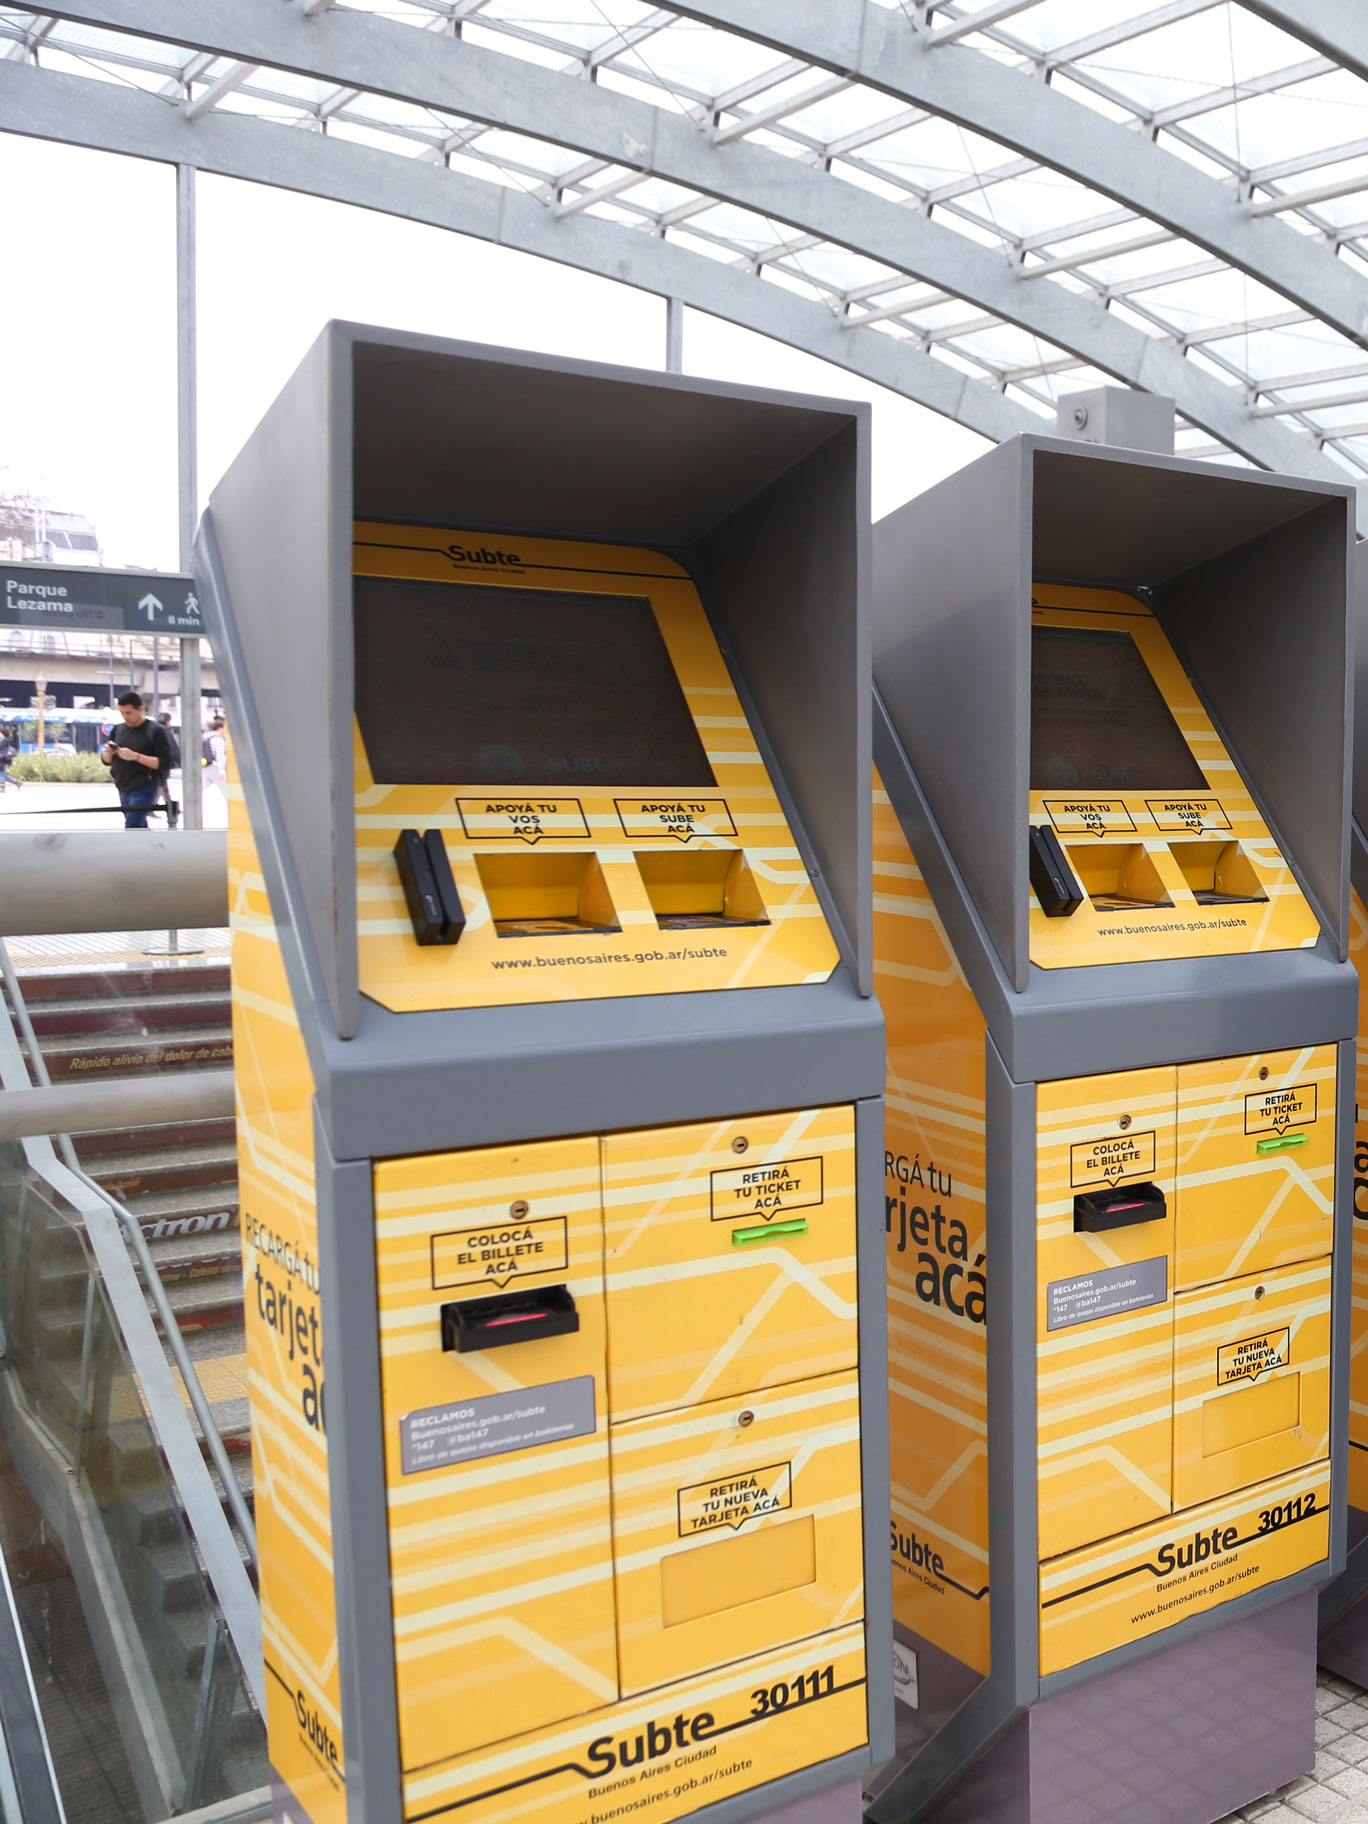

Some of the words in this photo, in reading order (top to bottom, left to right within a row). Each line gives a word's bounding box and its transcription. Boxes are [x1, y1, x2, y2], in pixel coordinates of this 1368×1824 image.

[448, 544, 520, 566] Subte
[6, 580, 68, 597] Parque
[7, 596, 73, 613] Lezama
[168, 615, 175, 625] 8
[178, 616, 200, 627] min
[485, 802, 533, 813] APOYÁ
[537, 804, 557, 813] TU
[641, 802, 685, 813] APOYÁ
[688, 804, 705, 813] TU
[1064, 803, 1096, 813] APOYÁ
[1099, 804, 1110, 812] TU
[1164, 802, 1192, 811] APOYÁ
[1194, 803, 1207, 811] TU
[508, 815, 540, 824] VOS
[659, 814, 694, 823] SUBE
[1080, 813, 1101, 821] VOS
[1086, 819, 1106, 830] ACÁ
[1185, 818, 1203, 828] ACÁ
[513, 824, 544, 834] ACÁ
[667, 824, 695, 834] ACÁ
[1097, 918, 1247, 936] www.buenosaires.gob.ar/subte
[491, 947, 728, 969] www.buenosaires.gob.ar/subte
[69, 1056, 110, 1070] Rápido
[113, 1053, 143, 1066] alivio
[145, 1052, 163, 1064] del
[165, 1049, 193, 1062] dolor
[196, 1047, 209, 1058] de
[1265, 1090, 1296, 1106] RETIRÁ
[1260, 1107, 1271, 1117] TU
[1273, 1102, 1303, 1115] TICKET
[1272, 1113, 1290, 1126] ACÁ
[1093, 1138, 1135, 1156] COLOCÁ
[1086, 1159, 1098, 1169] EL
[1101, 1150, 1141, 1166] BILLETE
[742, 1166, 789, 1184] RETIRÁ
[1103, 1162, 1124, 1177] ACÁ
[928, 1161, 952, 1198] tu
[734, 1187, 752, 1199] TU
[755, 1179, 801, 1196] TICKET
[754, 1194, 782, 1209] ACÁ
[467, 1226, 533, 1248] COLOCÁ
[245, 1212, 306, 1285] RECARGÁ
[457, 1252, 476, 1265] EL
[481, 1241, 544, 1261] BILLETE
[485, 1257, 517, 1275] ACÁ
[915, 1252, 987, 1326] acá
[1053, 1280, 1094, 1296] RECLAMOS
[1053, 1280, 1137, 1305] Buenosaires.gob.ar/subte
[1053, 1313, 1068, 1324] Libro
[1237, 1337, 1268, 1355] RETIRÁ
[1225, 1361, 1262, 1379] TARJETA
[1264, 1353, 1282, 1368] ACÁ
[1233, 1356, 1244, 1367] TU
[1246, 1347, 1275, 1363] NUEVA
[410, 1407, 476, 1428] RECLAMOS
[411, 1405, 546, 1441] Buenosaires.gob.ar/subte
[710, 1475, 758, 1498] RETIRÁ
[702, 1500, 720, 1513] TU
[724, 1488, 768, 1507] NUEVA
[691, 1505, 749, 1529] TARJETA
[752, 1494, 780, 1513] ACÁ
[1157, 1526, 1238, 1577] Subte
[1257, 1492, 1316, 1533] 30112
[1156, 1575, 1187, 1593] Buenos
[1189, 1566, 1209, 1580] Aires
[1210, 1553, 1238, 1571] Ciudad
[1131, 1564, 1260, 1624] www.buenosaires.gob.ar/subte
[297, 1689, 338, 1763] Subte
[587, 1711, 715, 1779] Subte
[750, 1665, 834, 1717] 30111
[588, 1775, 636, 1799] Buenos
[639, 1763, 671, 1782] Aires
[674, 1744, 717, 1768] Ciudad
